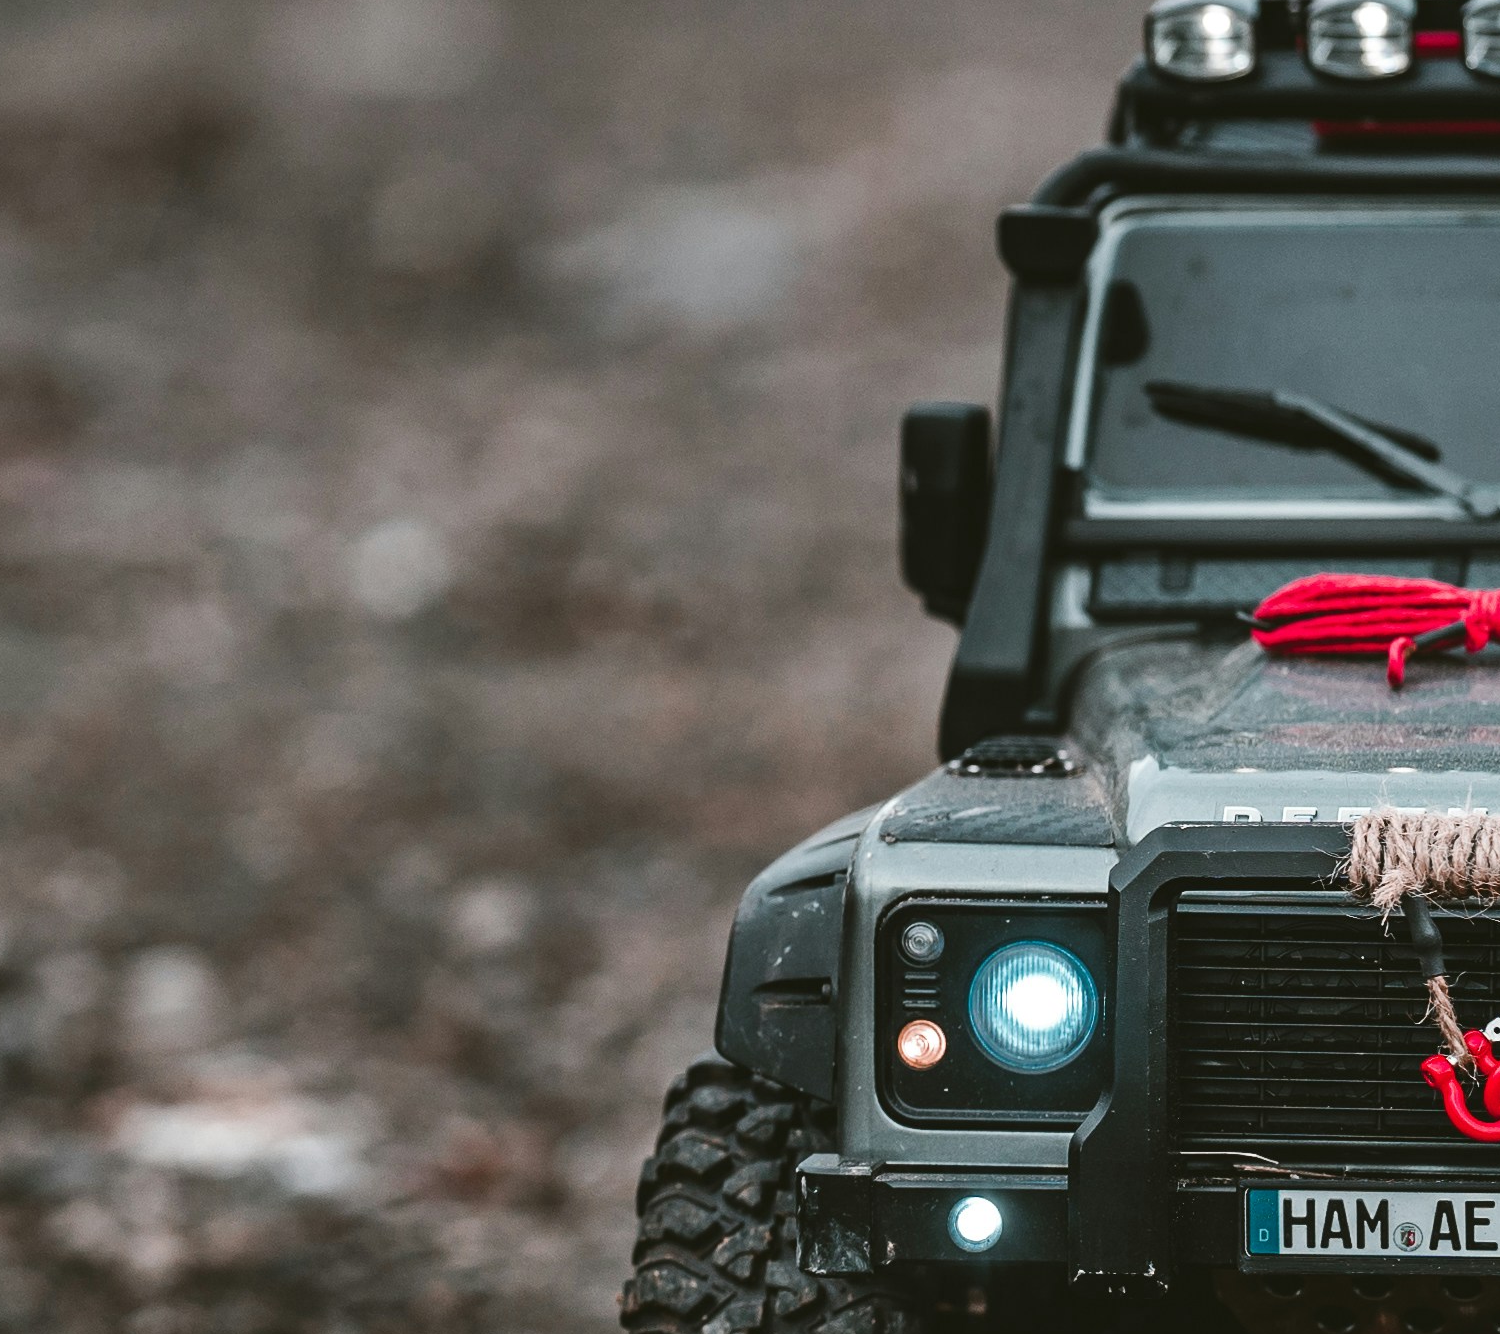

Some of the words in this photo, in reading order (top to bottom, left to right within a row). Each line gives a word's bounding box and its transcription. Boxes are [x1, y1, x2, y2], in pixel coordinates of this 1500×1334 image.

[1258, 1228, 1270, 1242] D
[1282, 1197, 1390, 1250] HAM
[1428, 1199, 1499, 1251] AE
